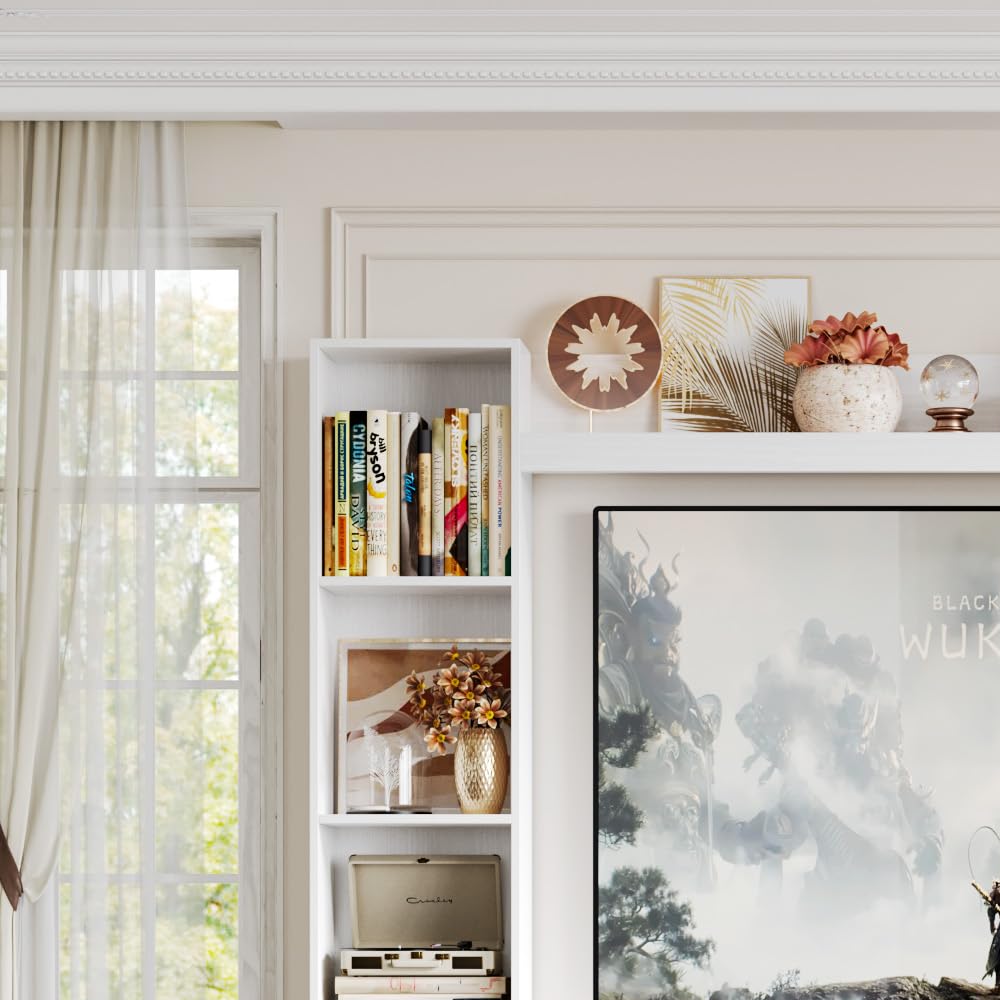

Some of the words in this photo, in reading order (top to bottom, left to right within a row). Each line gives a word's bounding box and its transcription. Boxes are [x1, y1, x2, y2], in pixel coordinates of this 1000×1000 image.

[352, 424, 366, 483] CYDONIA
[367, 432, 386, 484] bryson
[378, 437, 387, 453] bill
[351, 496, 360, 552] DAVID
[932, 595, 1000, 611] BLACK
